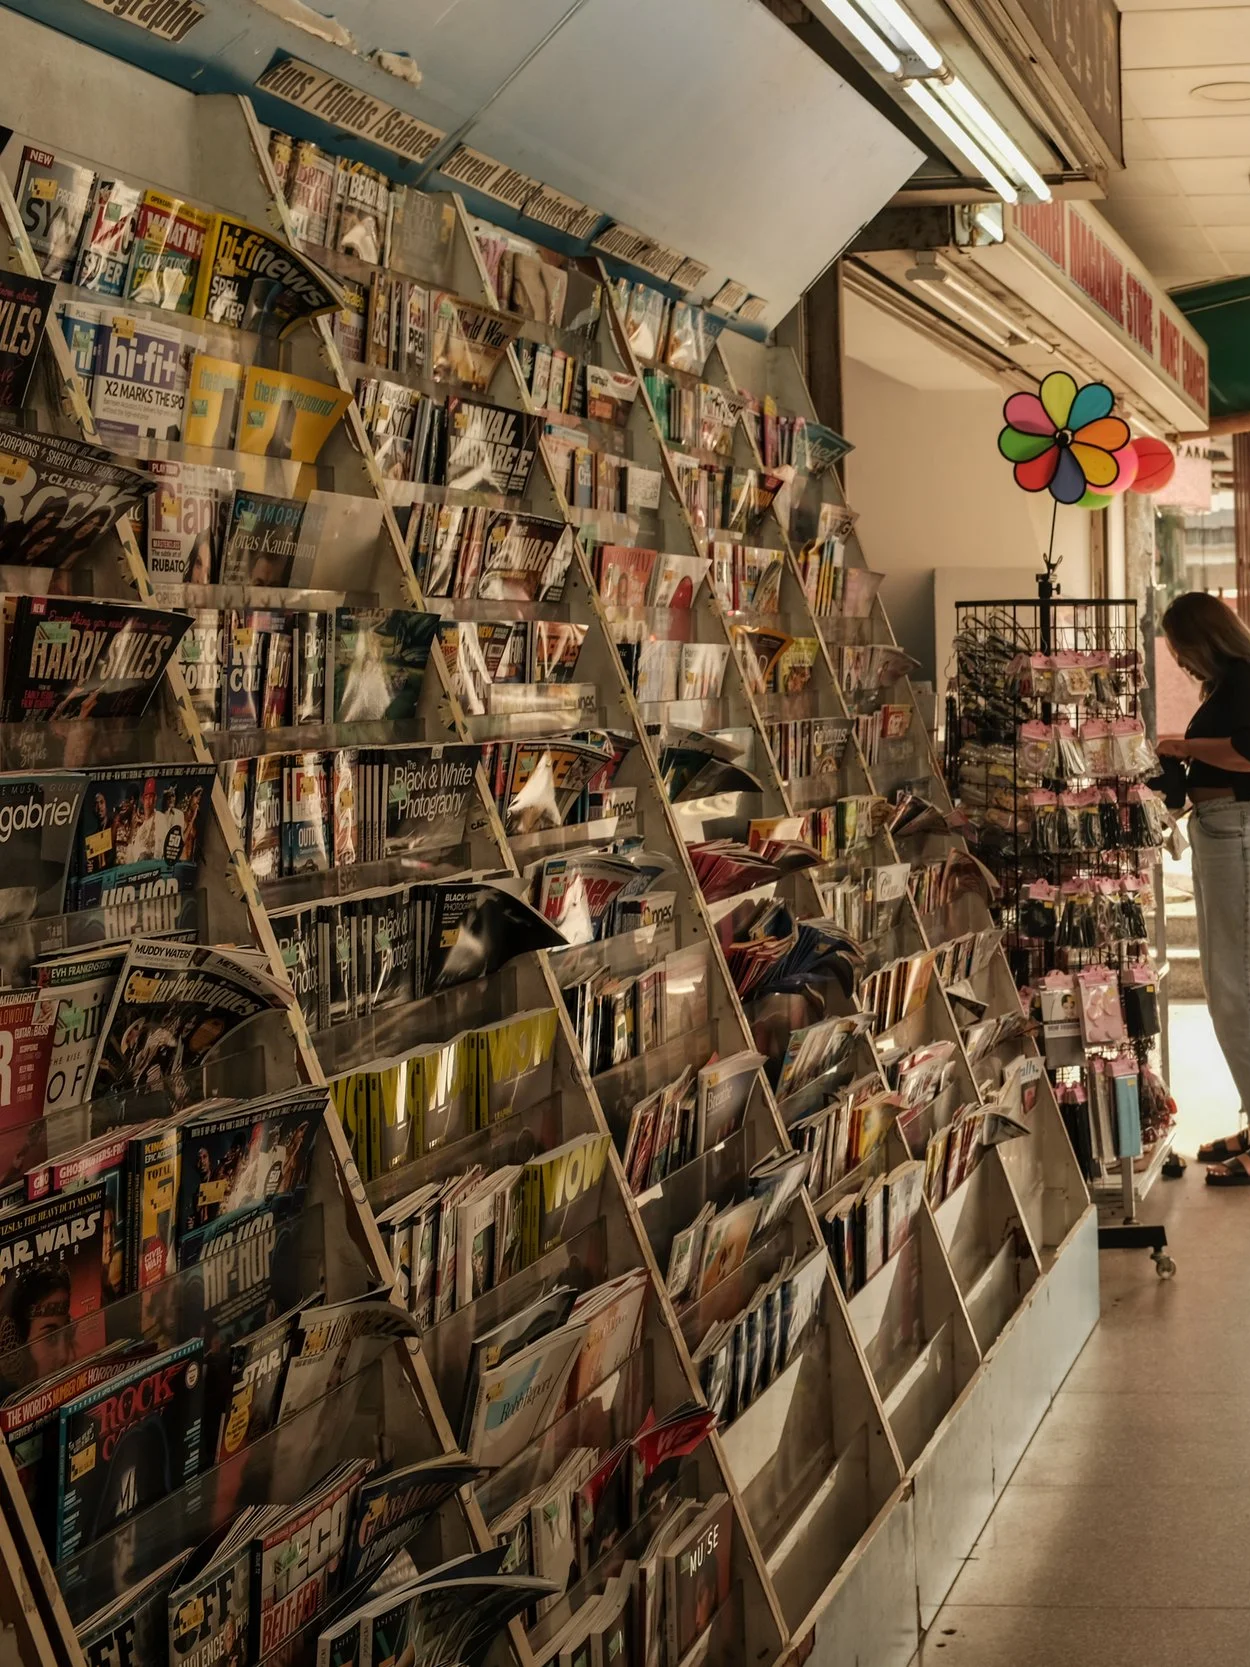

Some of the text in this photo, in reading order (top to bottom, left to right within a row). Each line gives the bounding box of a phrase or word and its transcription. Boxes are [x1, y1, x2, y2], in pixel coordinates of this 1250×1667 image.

[259, 60, 316, 100] Guns
[313, 82, 379, 124] Flights
[30, 150, 53, 166] NEW
[441, 147, 539, 206] Current Affairs
[525, 186, 578, 228] Business
[253, 243, 327, 308] news
[105, 380, 119, 397] X2
[120, 384, 153, 405] MARKS
[155, 390, 170, 408] THE
[46, 448, 73, 470] SHERYL
[48, 473, 95, 494] CLASSIC
[230, 527, 260, 552] Jonas
[152, 559, 185, 574] RUBATO
[29, 625, 173, 682] HARRY STYLES
[394, 763, 473, 791] Black & White
[407, 760, 417, 771] The
[0, 793, 79, 843] gabriel
[397, 789, 466, 822] Photography
[168, 834, 182, 847] 50
[377, 914, 408, 937] Black &
[135, 944, 191, 959] MUDDY WATERS
[51, 960, 113, 979] EVH FRANKENSTEIN
[146, 1165, 171, 1182] TOTAL
[24, 1215, 38, 1227] THE
[38, 1207, 60, 1222] HEAVY
[59, 1200, 76, 1212] DUTY
[35, 1210, 101, 1257] WARS
[145, 1253, 163, 1271] WAR
[233, 1350, 288, 1392] STAR
[7, 1363, 126, 1430] THE WORLD'S NUMBER ONE HORROR
[90, 1361, 186, 1439] ROCK
